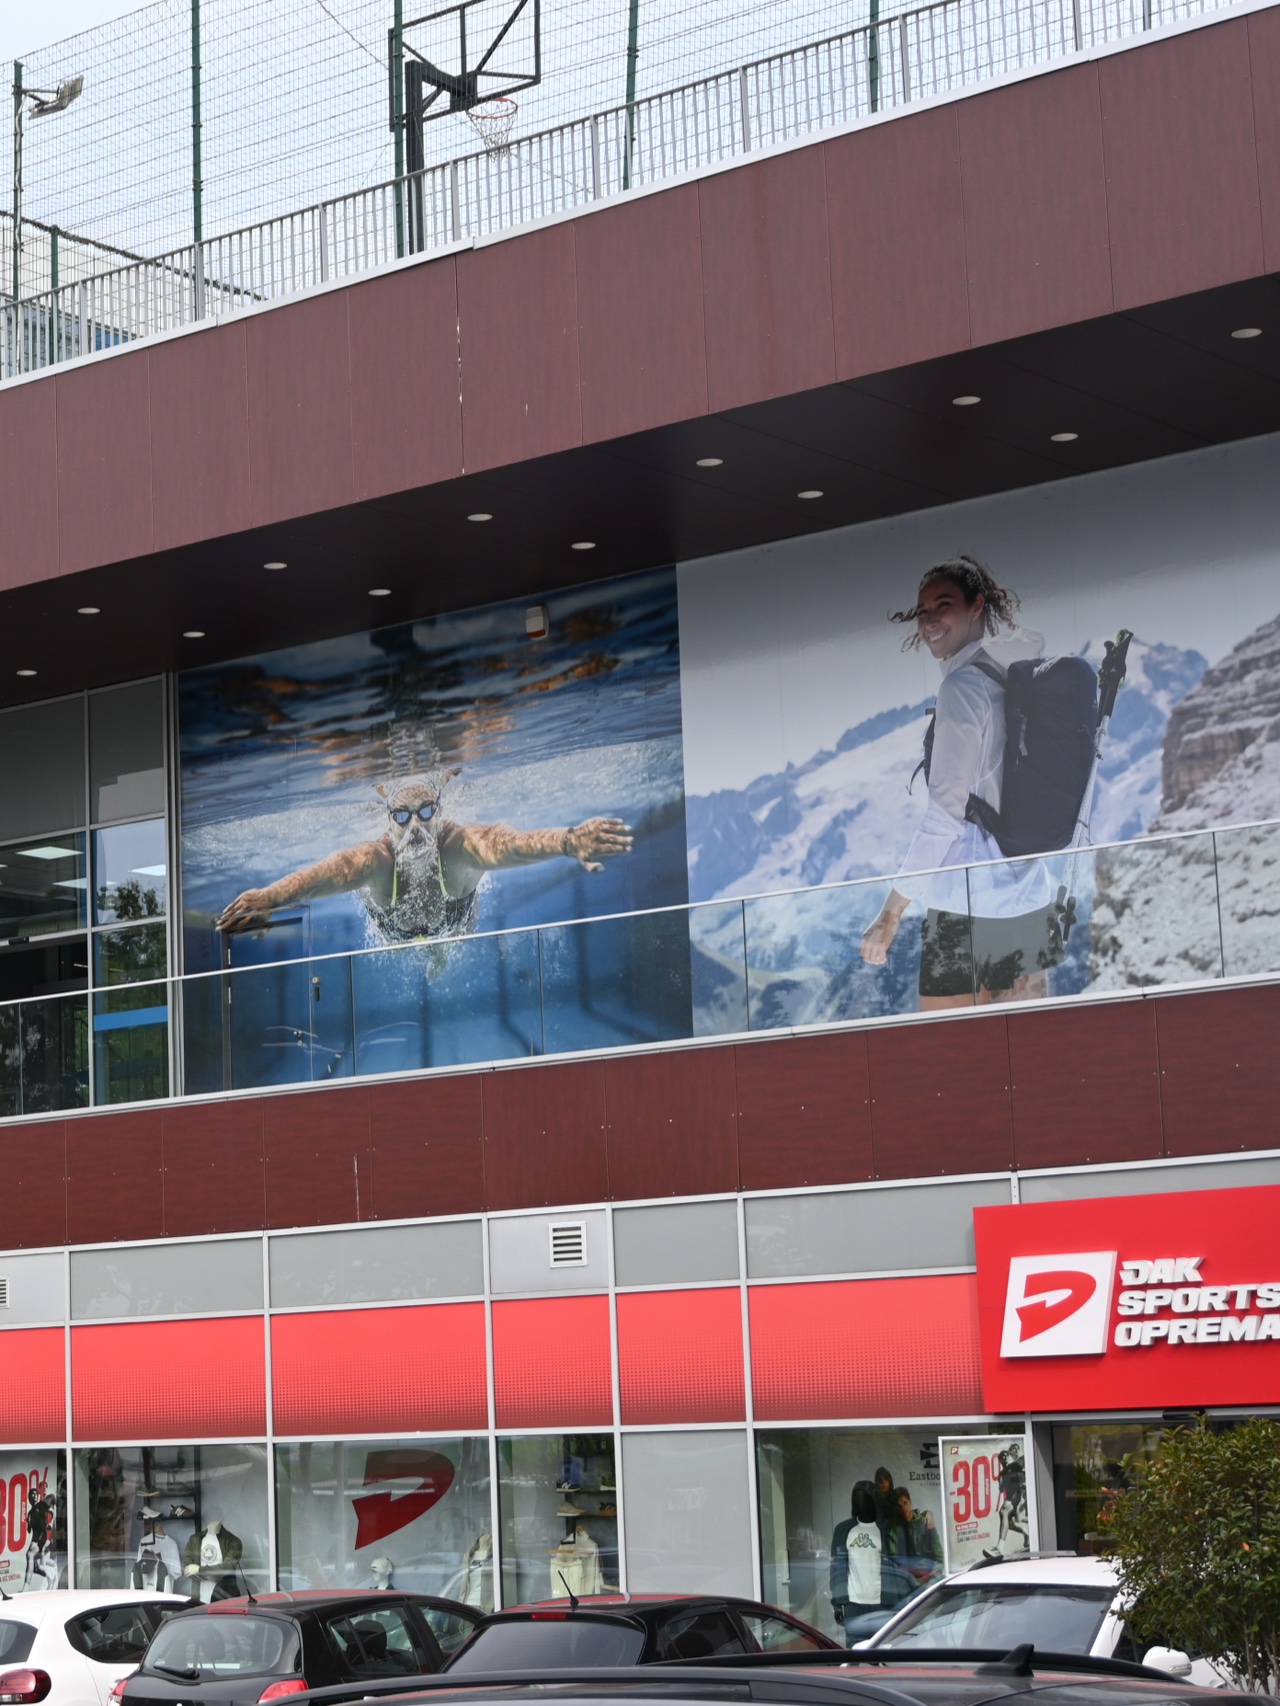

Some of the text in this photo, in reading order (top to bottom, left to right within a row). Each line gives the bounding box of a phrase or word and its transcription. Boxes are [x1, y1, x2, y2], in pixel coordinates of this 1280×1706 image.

[1119, 1256, 1206, 1287] DAK
[1117, 1282, 1280, 1316] SPORTS
[1114, 1313, 1280, 1347] OPREMA
[909, 1470, 941, 1481] Eastbo
